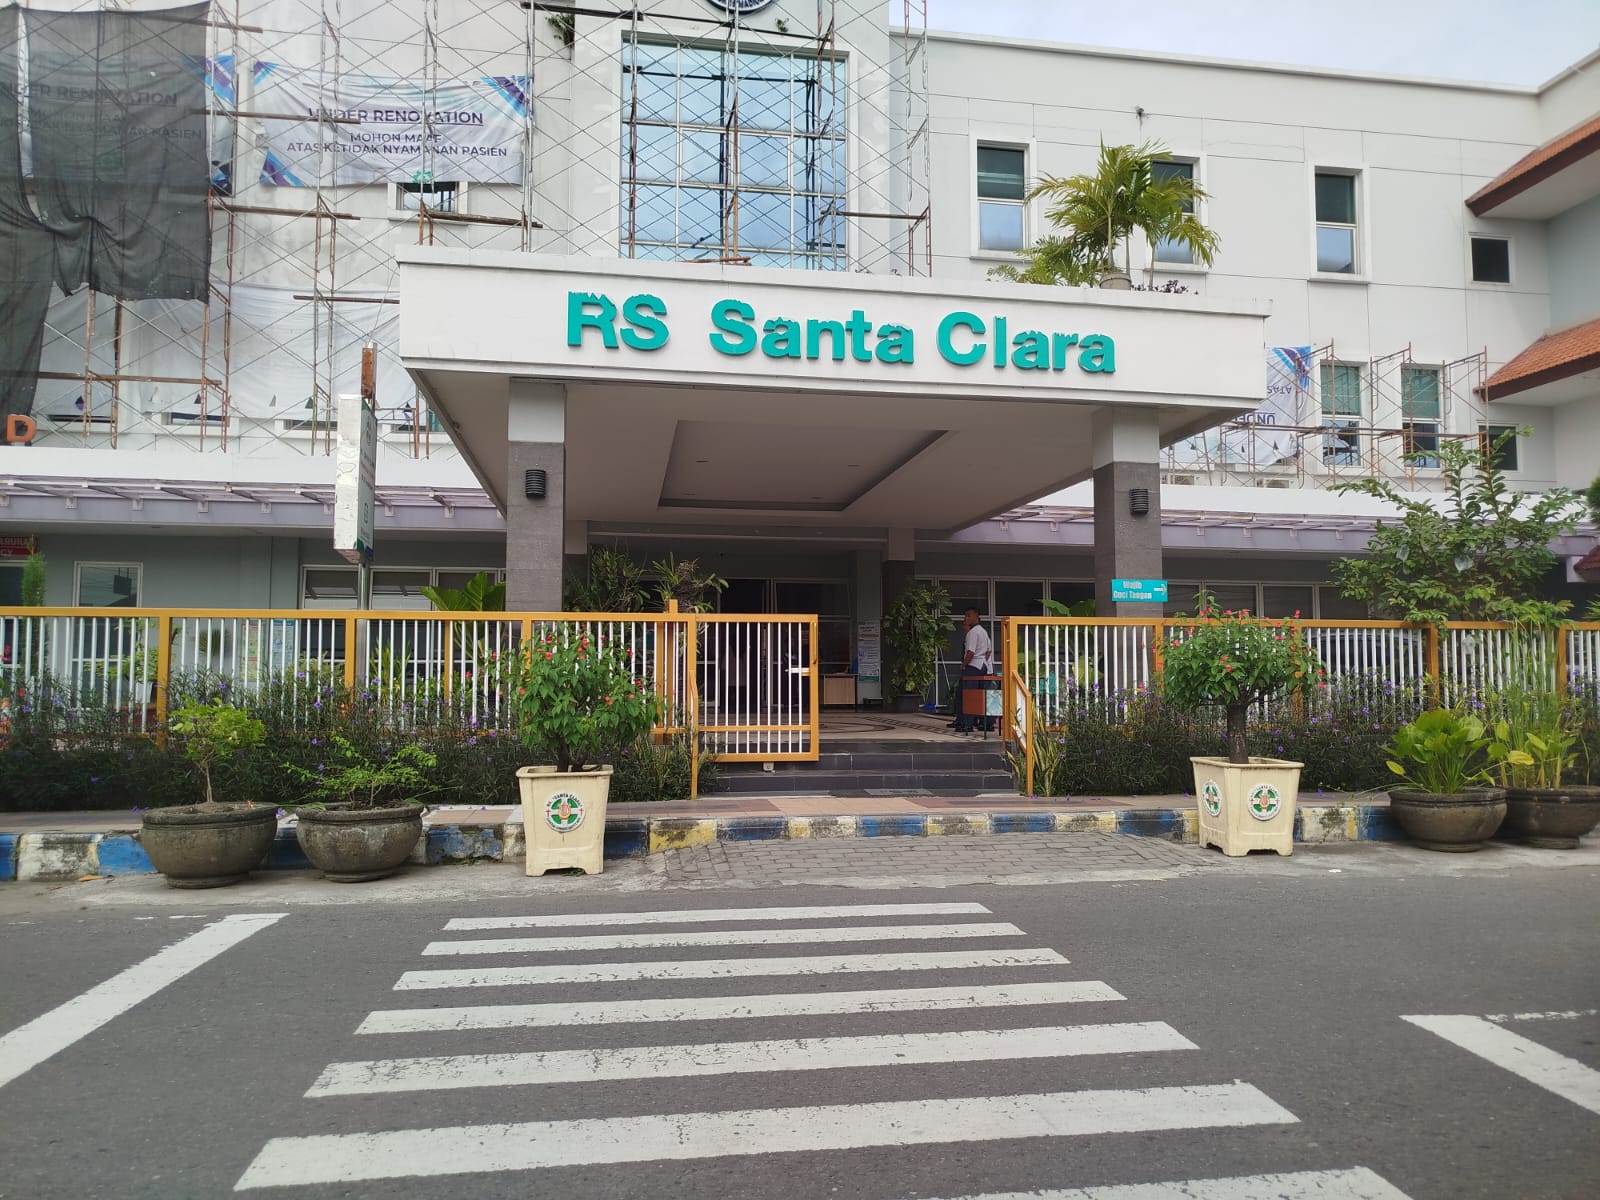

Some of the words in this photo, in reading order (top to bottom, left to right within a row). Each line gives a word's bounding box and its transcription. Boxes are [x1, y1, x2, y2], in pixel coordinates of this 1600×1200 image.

[350, 133, 401, 142] MOHON
[463, 147, 507, 157] PASIEN
[568, 292, 669, 350] RS
[710, 299, 914, 364] Santa
[938, 312, 1116, 374] Clara
